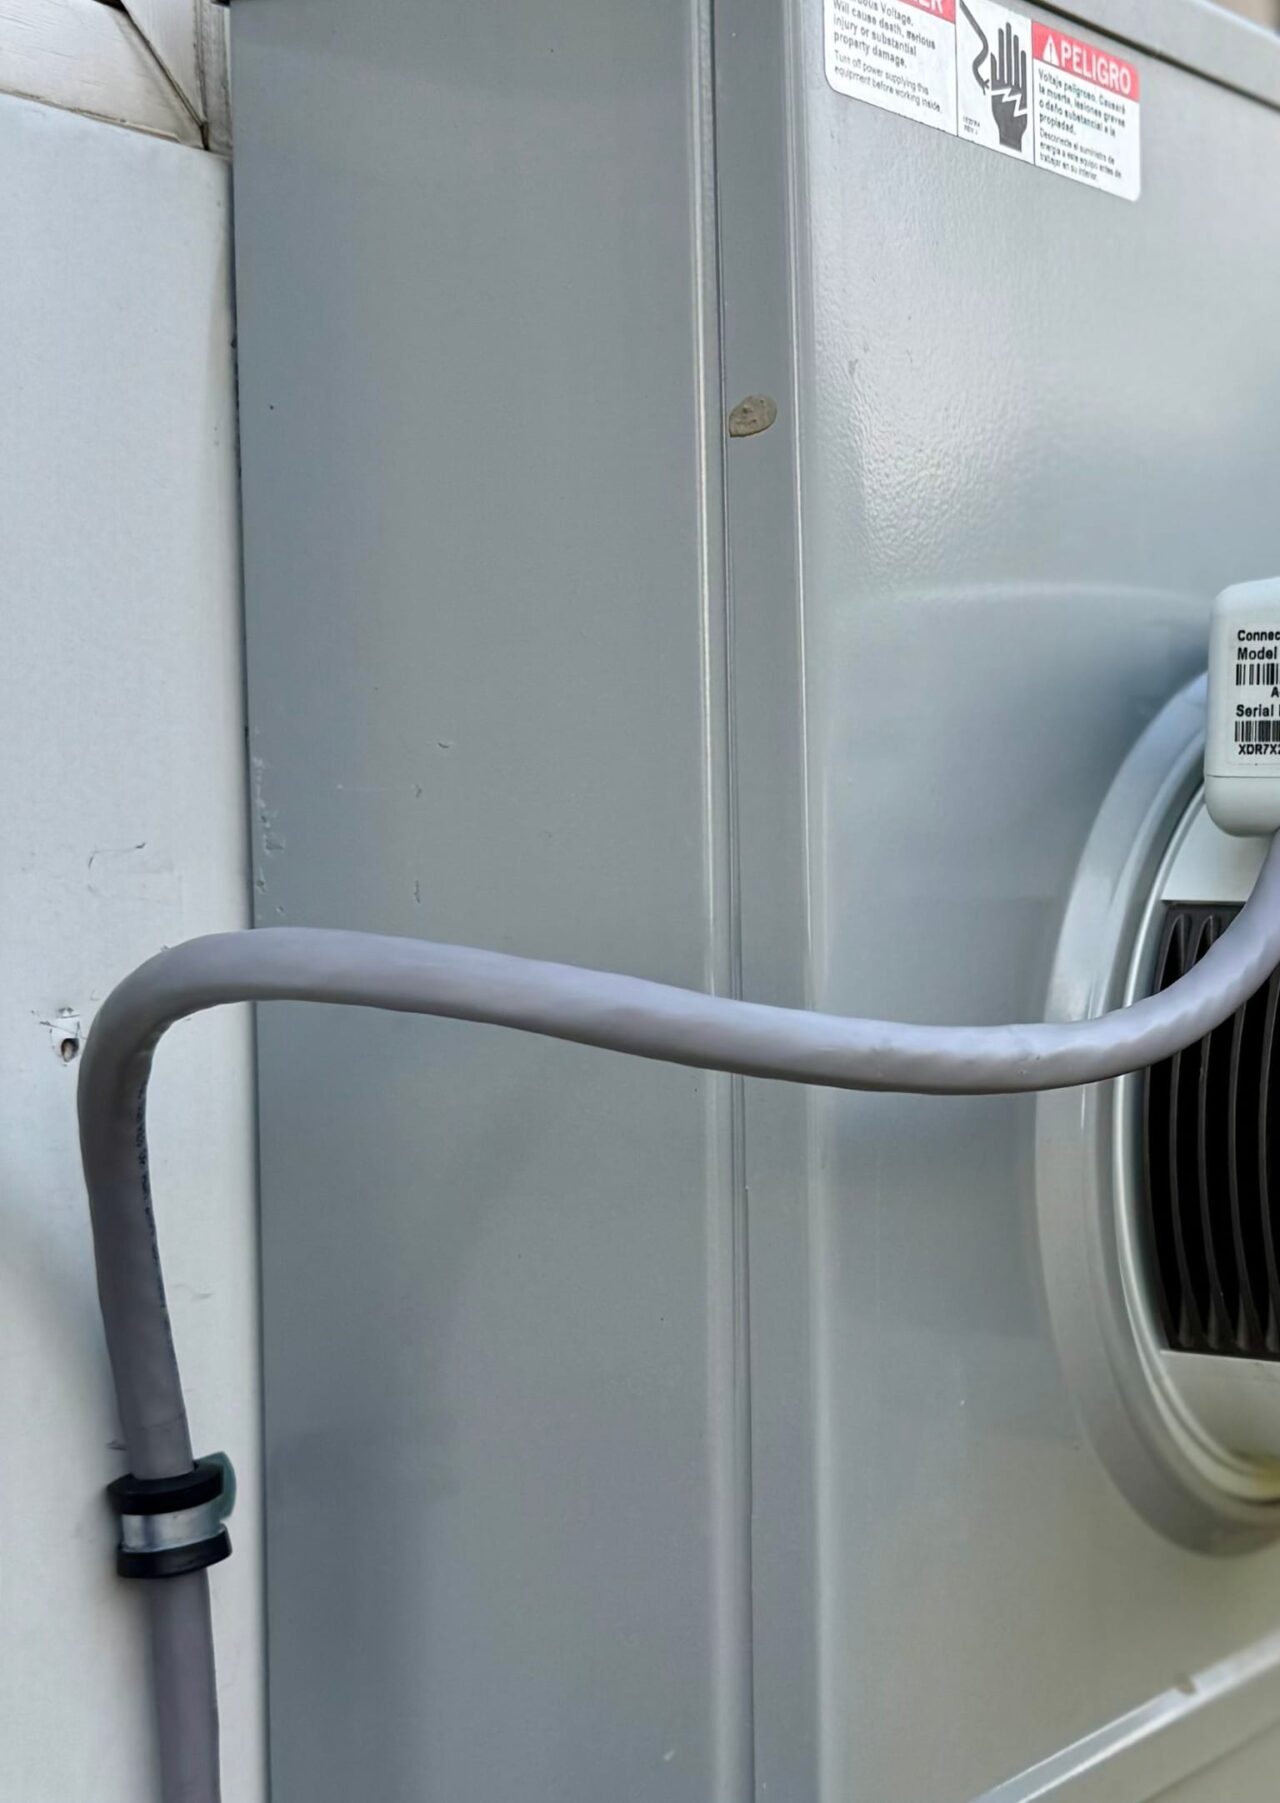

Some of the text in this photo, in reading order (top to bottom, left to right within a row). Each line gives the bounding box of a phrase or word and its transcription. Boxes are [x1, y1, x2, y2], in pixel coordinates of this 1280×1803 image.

[851, 7, 877, 26] cause
[833, 13, 917, 57] injury or substantial
[834, 31, 870, 56] property
[1060, 40, 1132, 95] PELIGRO
[1237, 646, 1278, 660] Model
[1235, 703, 1274, 717] Serial
